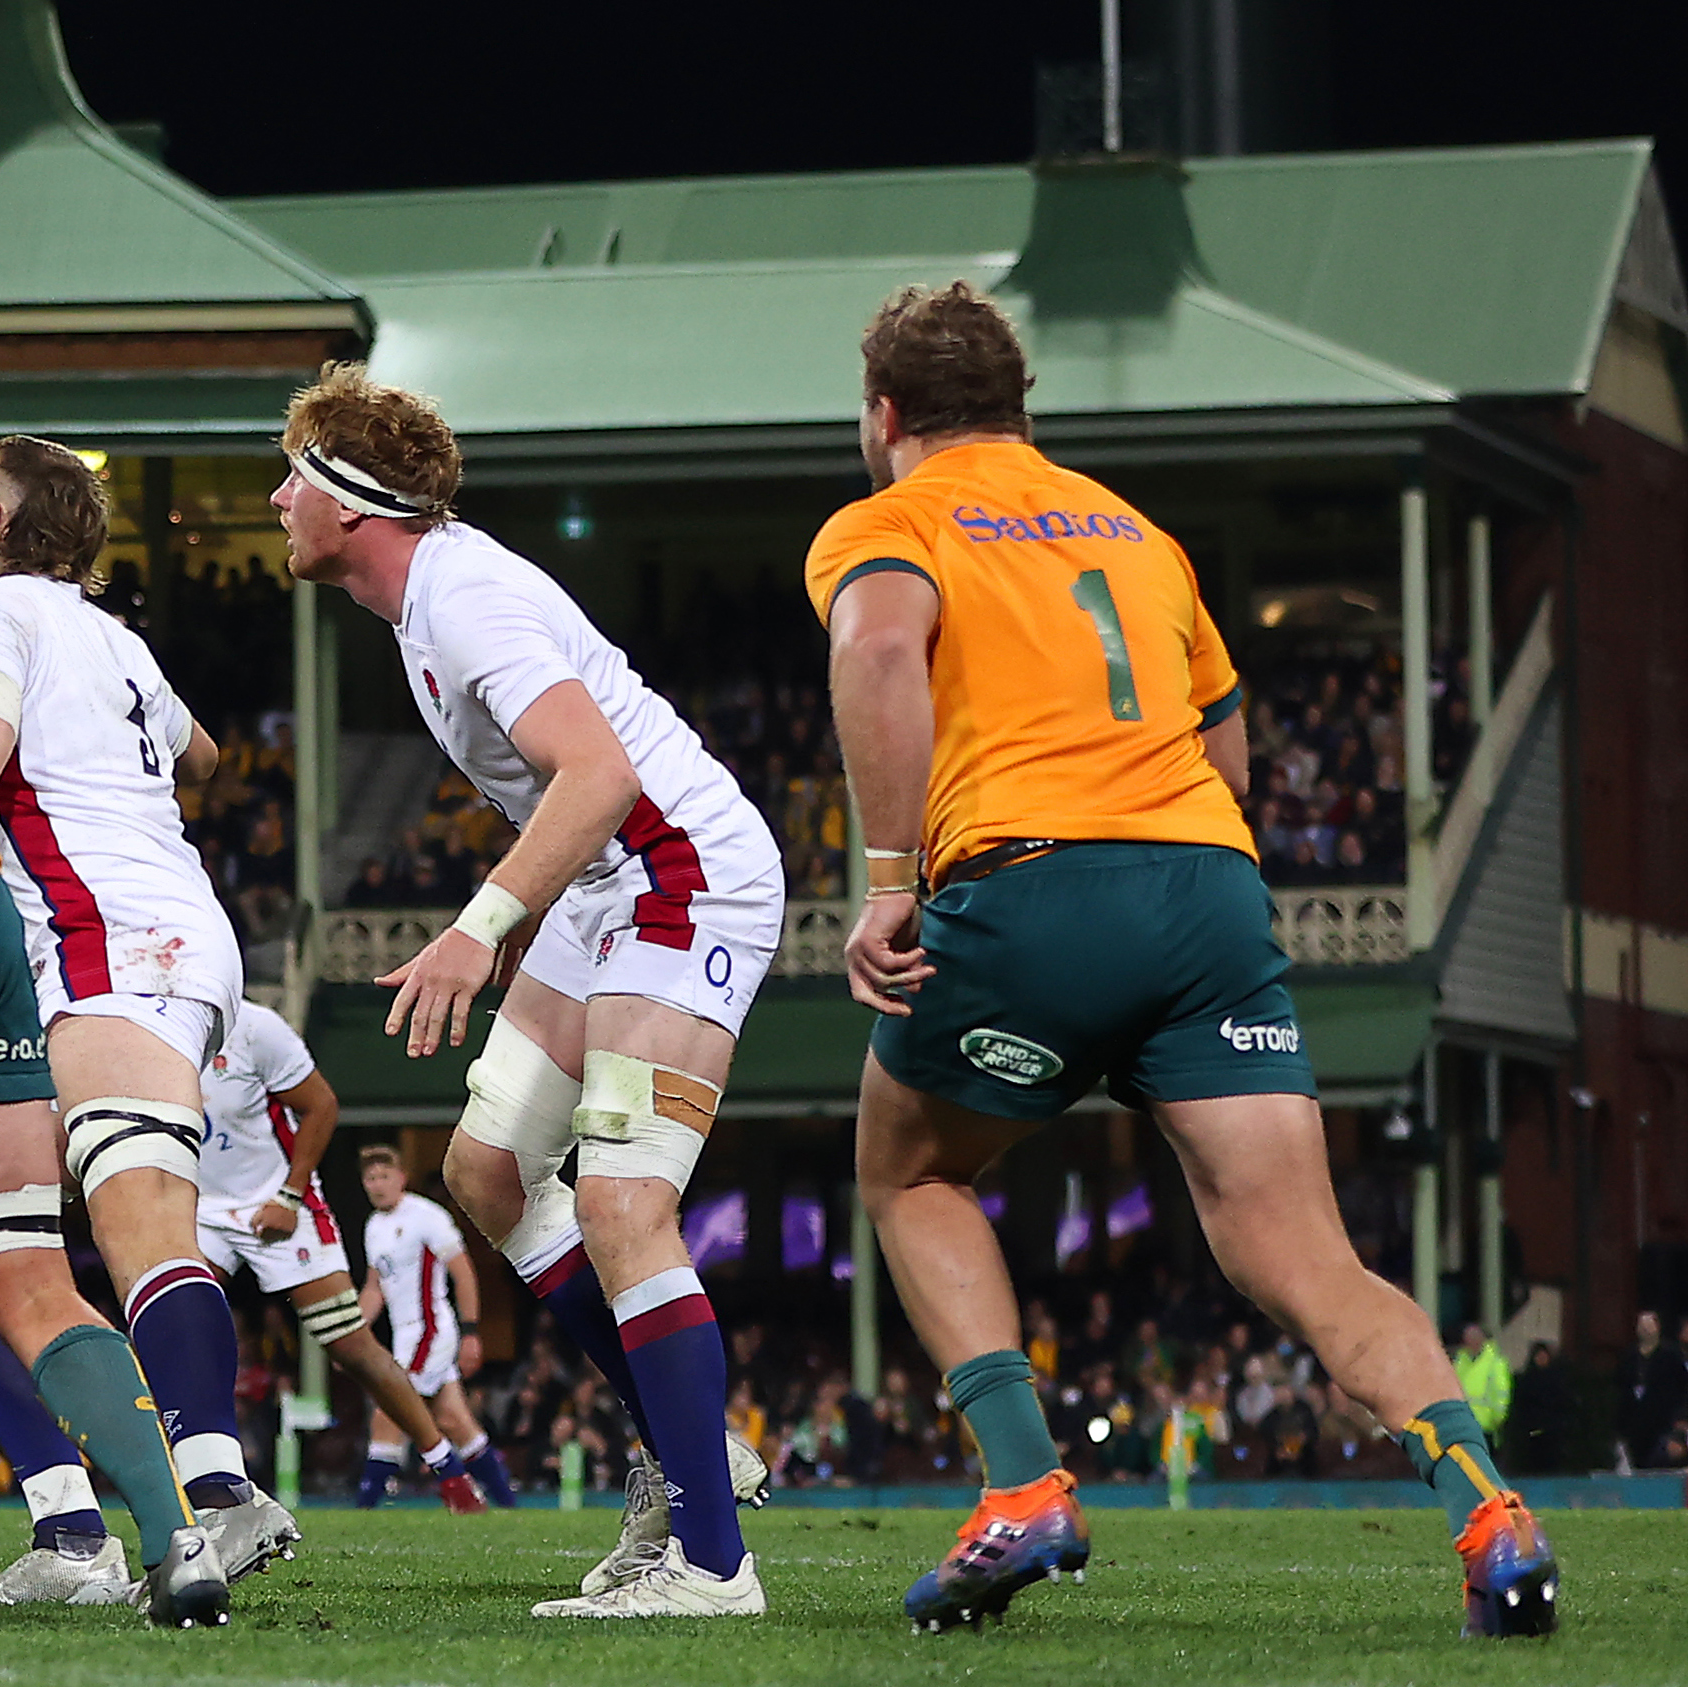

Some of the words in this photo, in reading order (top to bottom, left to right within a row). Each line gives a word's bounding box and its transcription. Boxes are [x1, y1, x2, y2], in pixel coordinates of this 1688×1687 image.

[953, 505, 1144, 543] Santos
[1069, 568, 1143, 722] 1
[981, 1037, 1029, 1061] LAND
